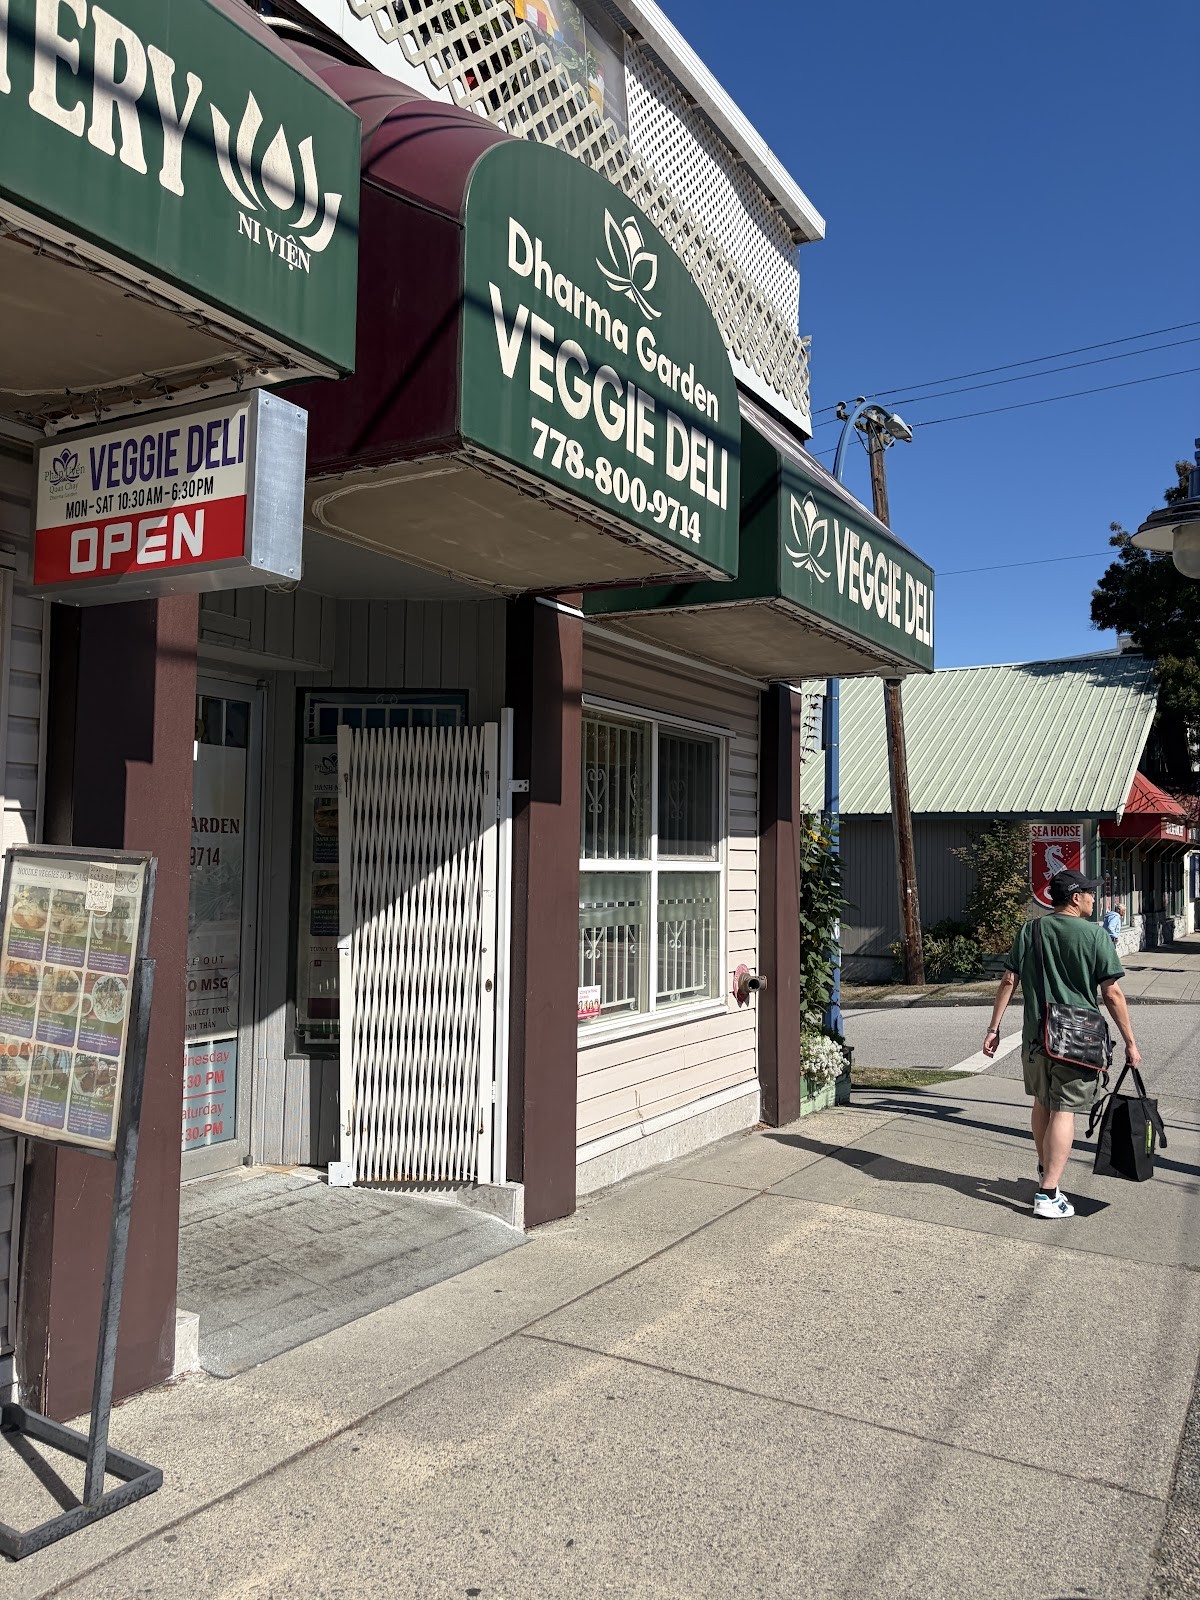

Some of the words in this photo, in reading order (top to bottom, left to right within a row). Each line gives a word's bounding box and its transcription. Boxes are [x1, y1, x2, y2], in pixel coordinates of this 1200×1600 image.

[238, 211, 260, 245] NI
[264, 234, 311, 274] VIỆN
[508, 216, 628, 355] Dharma
[636, 326, 719, 422] Garden
[488, 281, 655, 465] VEGGIE
[665, 409, 728, 510] DELI
[90, 428, 181, 491] VEGGIE
[186, 414, 246, 474] DELI
[531, 417, 701, 544] 778-800-9714
[65, 494, 114, 520] MON-SAT
[70, 508, 205, 575] OPEN
[833, 518, 902, 629] VEGGIE
[904, 572, 934, 648] DELI
[1031, 825, 1049, 837] SEA
[1050, 825, 1081, 837] HORSE
[203, 955, 225, 965] OUT
[201, 977, 228, 991] MSG
[188, 1007, 209, 1017] SWEET
[211, 1006, 230, 1014] TIMES
[205, 1069, 225, 1086] PM
[203, 1120, 224, 1137] PM
